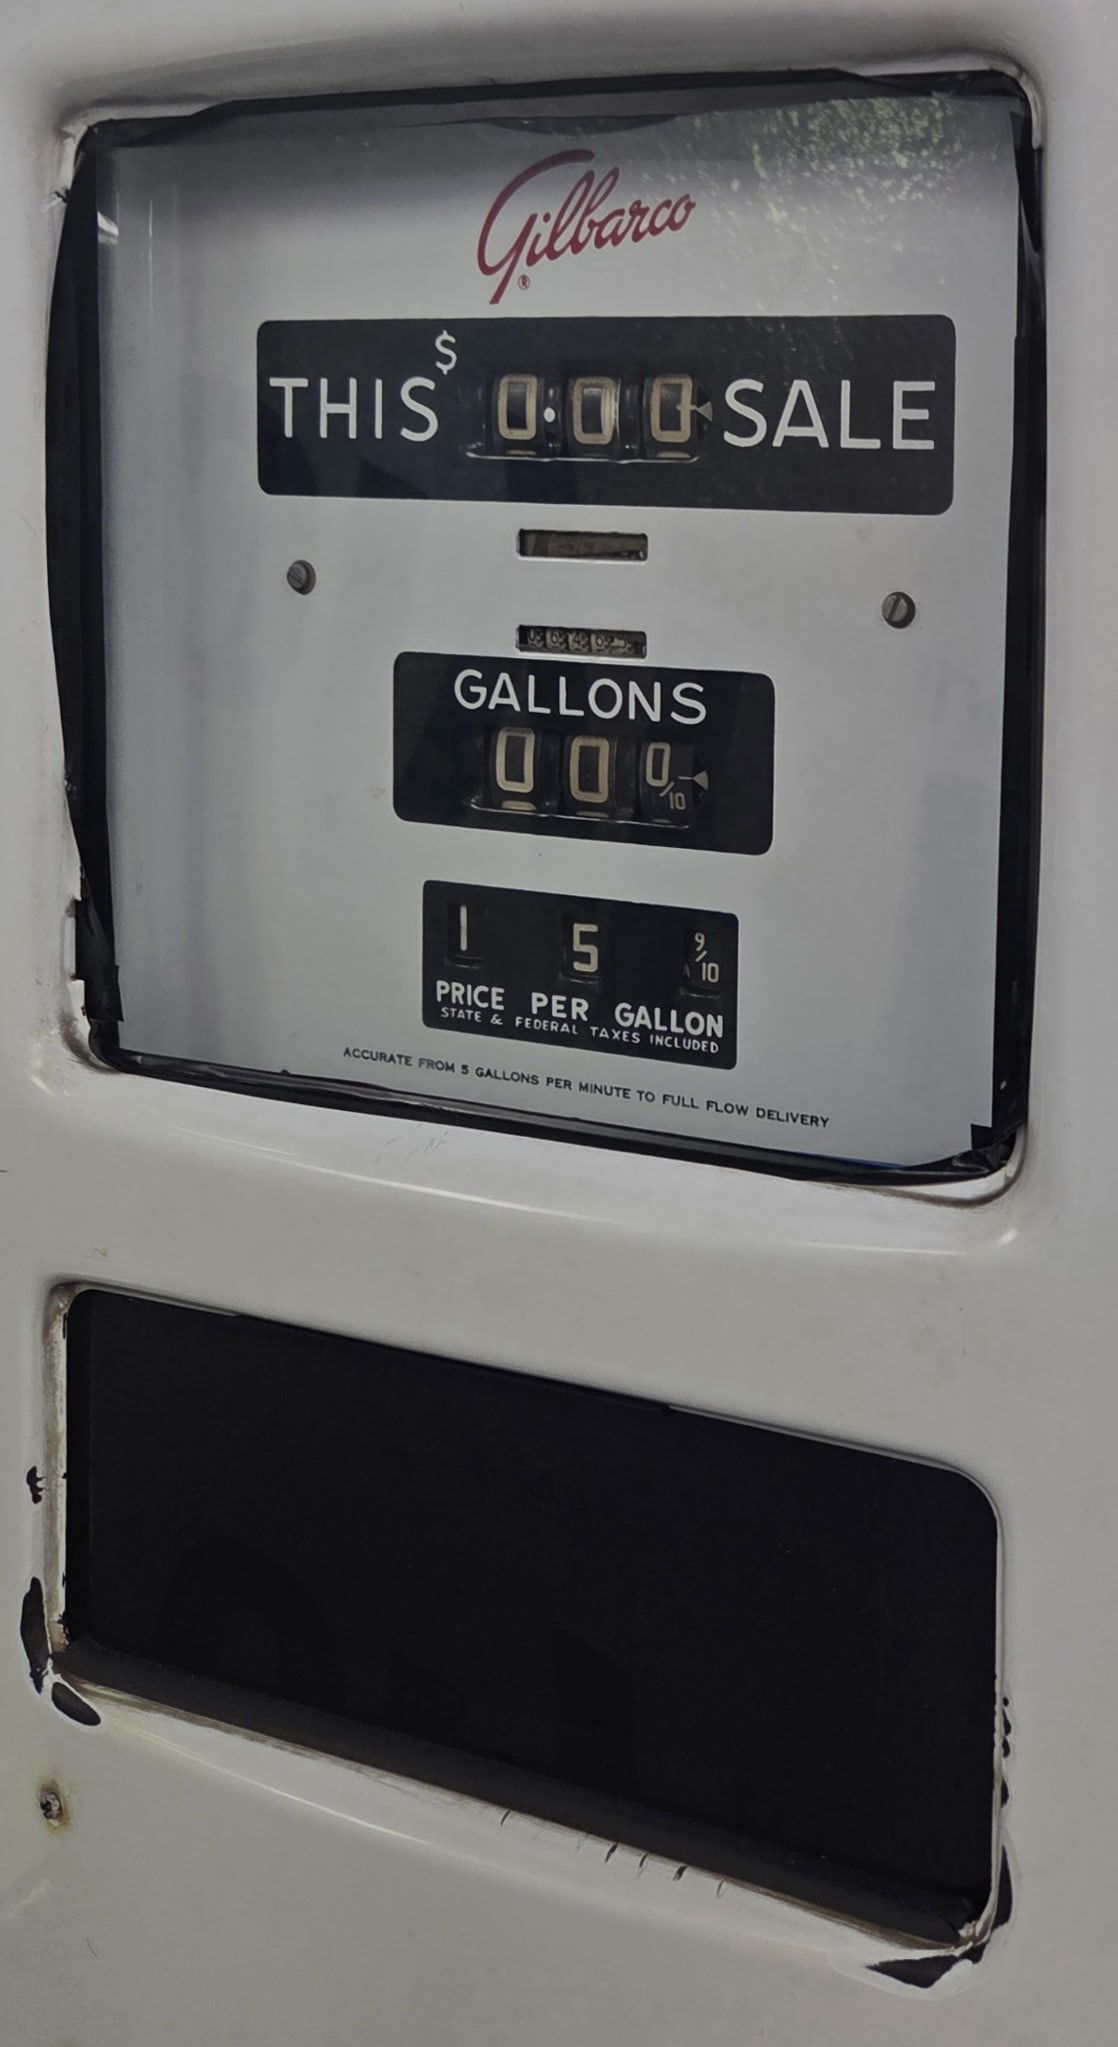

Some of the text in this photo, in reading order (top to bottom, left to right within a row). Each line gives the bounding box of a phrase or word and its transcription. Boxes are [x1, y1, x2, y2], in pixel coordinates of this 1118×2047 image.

[477, 149, 696, 305] Gilbarco
[269, 377, 438, 443] THIS
[434, 330, 458, 375] $
[723, 378, 936, 451] SALE
[454, 669, 708, 724] GALLONS
[572, 923, 599, 973] 5
[436, 980, 724, 1038] PRICE PER GALLON
[440, 1006, 719, 1053] STATE & FEDERAL TAXES INCLUDED
[343, 1047, 830, 1128] ACCURATE FROM 5 GALLONS PER MINUTE TO FULL FLOW DELIVERY
